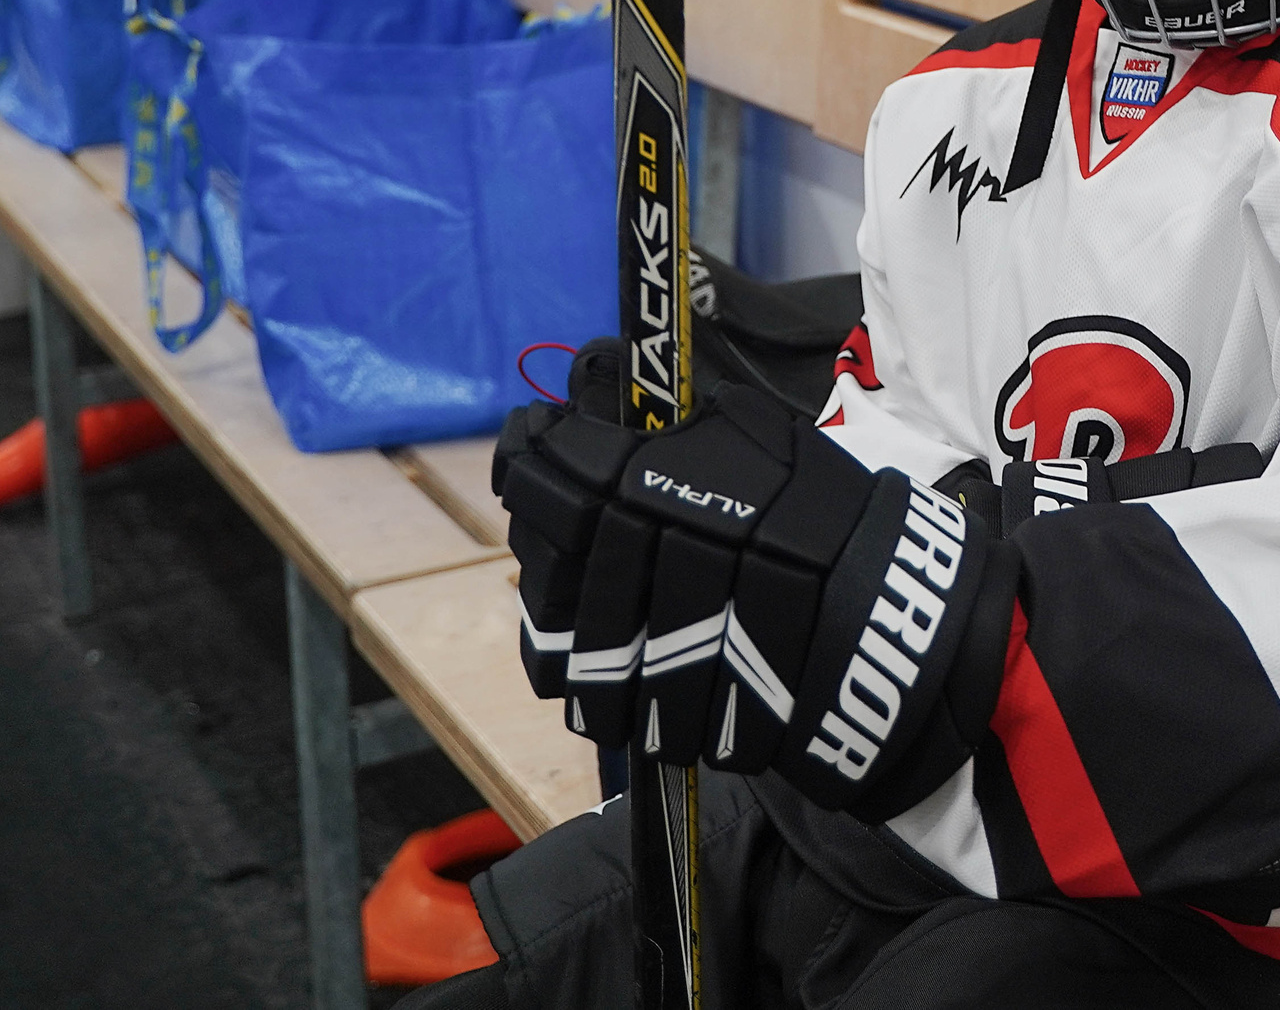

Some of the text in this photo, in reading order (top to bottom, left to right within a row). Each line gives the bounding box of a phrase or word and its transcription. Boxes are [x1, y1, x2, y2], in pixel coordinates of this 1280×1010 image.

[1144, 0, 1246, 29] BAUER
[1123, 58, 1161, 73] HOCKEY
[1110, 75, 1160, 104] VIKHR
[1105, 104, 1147, 121] RUSSIA
[638, 132, 658, 194] 2.0
[630, 195, 681, 409] TACKS
[643, 469, 757, 519] ALPHA
[806, 477, 967, 782] ARRIOR
